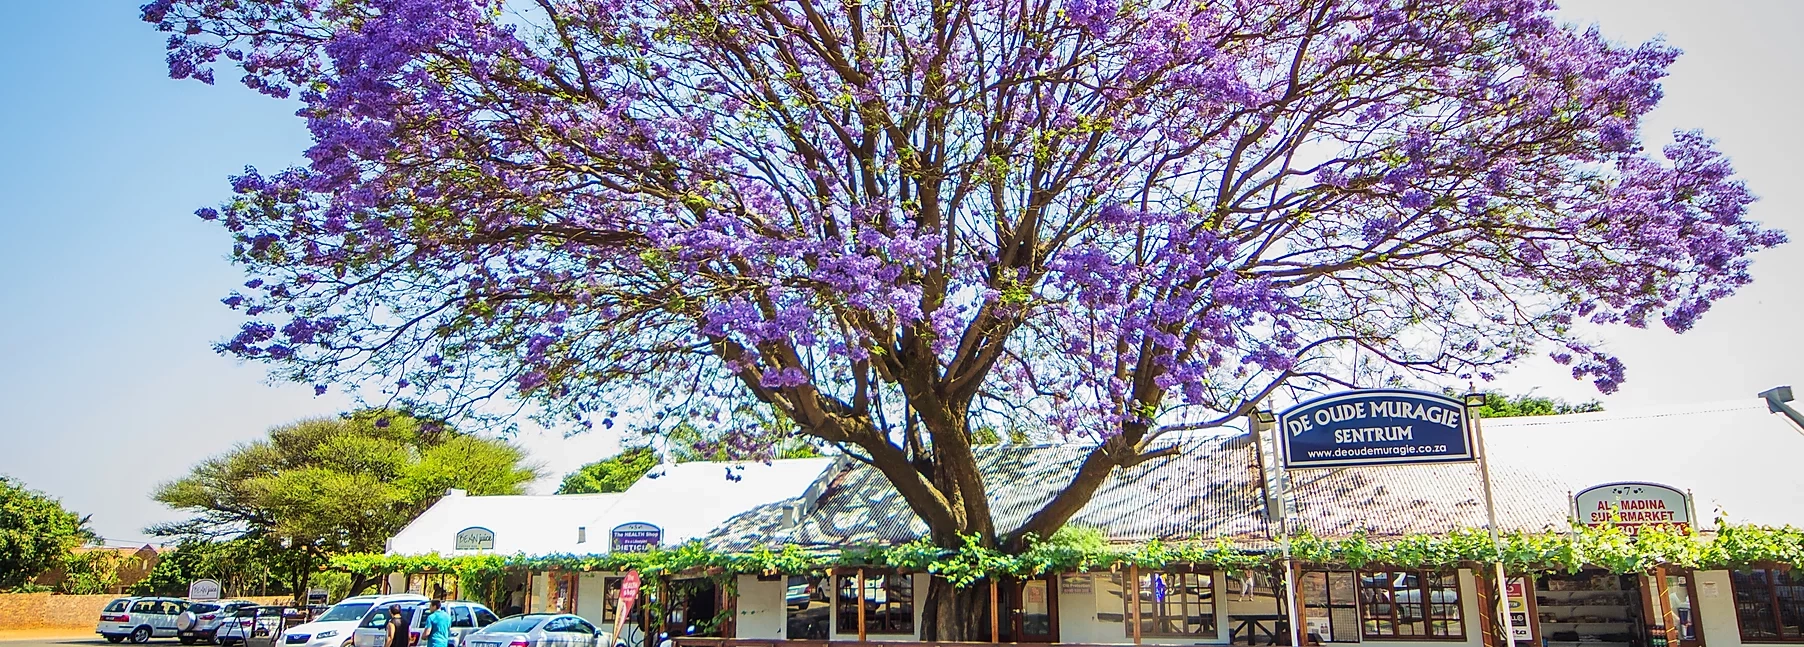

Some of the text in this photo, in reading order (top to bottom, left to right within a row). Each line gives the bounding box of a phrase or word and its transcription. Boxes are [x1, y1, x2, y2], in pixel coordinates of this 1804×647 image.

[1288, 401, 1460, 437] DE OUDE MURAGIE
[1335, 426, 1413, 444] SENTRUM
[1308, 444, 1447, 459] www.deoudemuragie.co.za
[1623, 487, 1631, 495] 7
[1621, 499, 1665, 510] MADINA
[478, 533, 492, 544] juice
